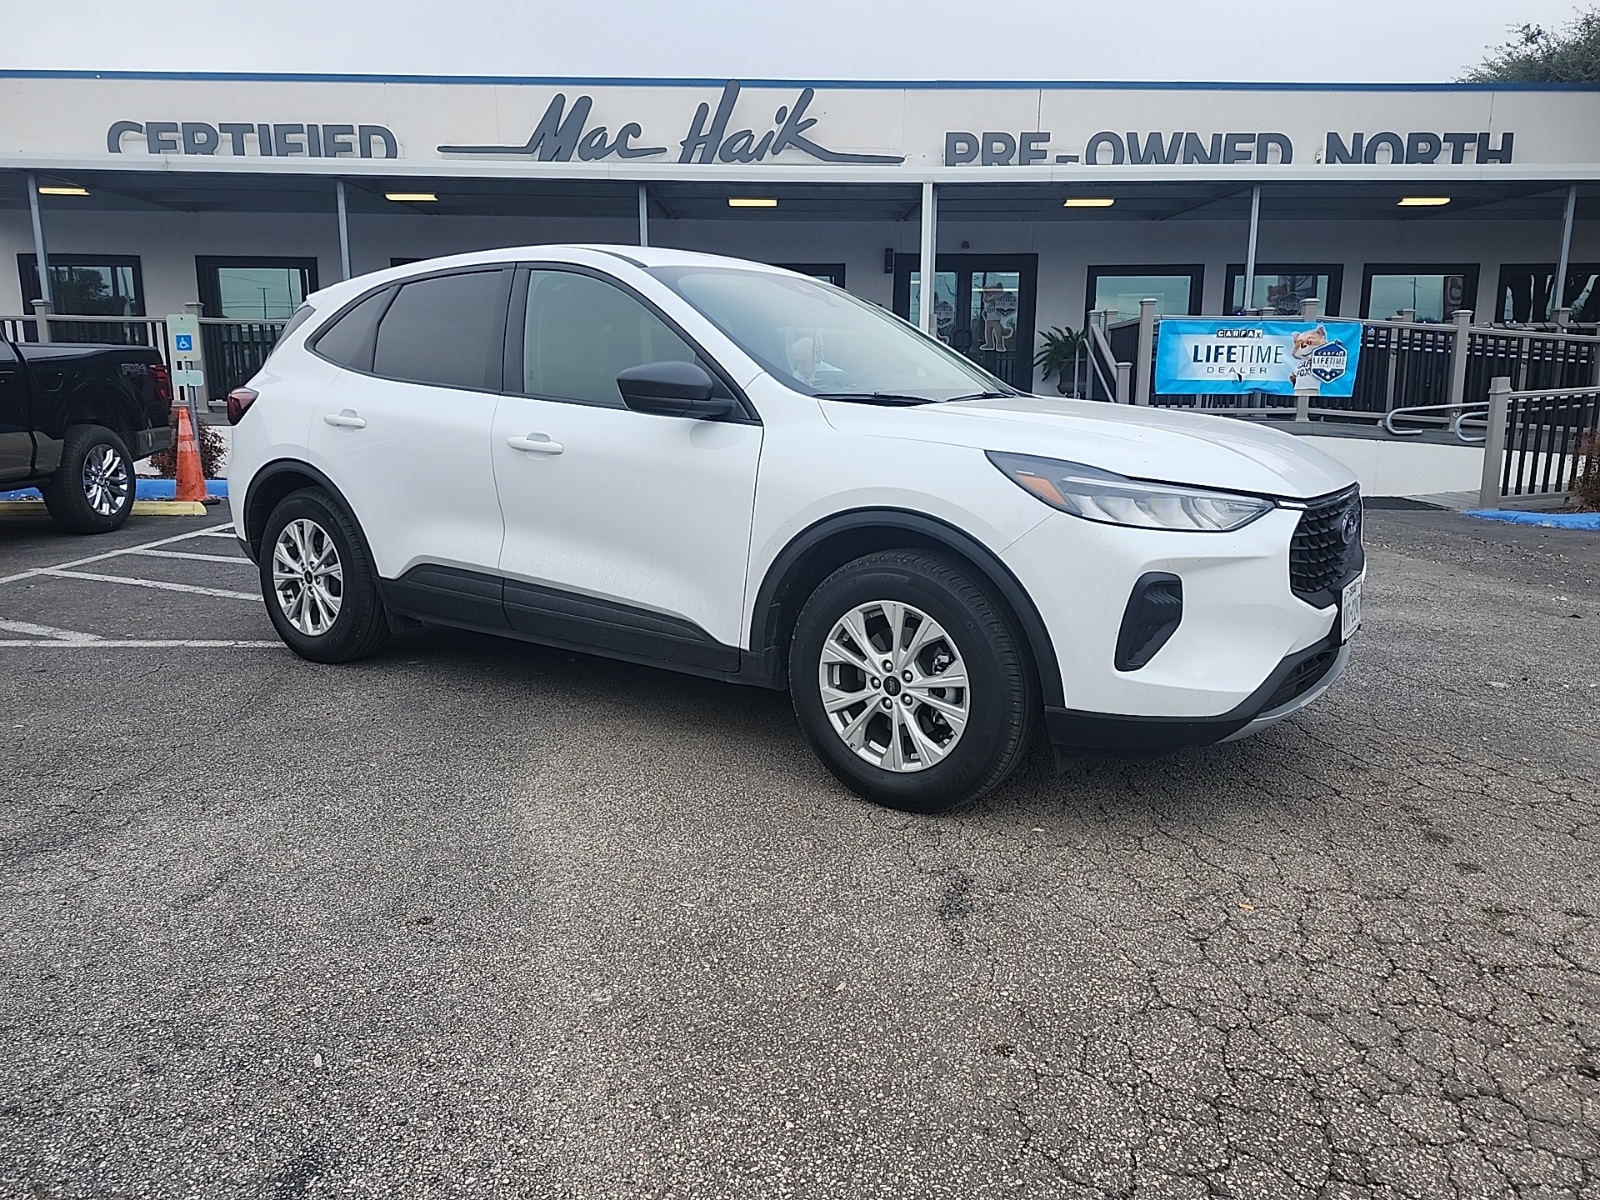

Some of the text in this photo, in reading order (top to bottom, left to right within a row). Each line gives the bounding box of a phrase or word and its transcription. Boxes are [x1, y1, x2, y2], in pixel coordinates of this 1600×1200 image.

[437, 79, 905, 164] Mac Haik
[107, 120, 398, 159] CERTIFIED
[1325, 132, 1515, 165] NORTH
[1217, 330, 1263, 338] CARFAX
[1192, 344, 1285, 364] LIFETIME
[1313, 356, 1346, 364] LIFETIME
[120, 363, 147, 376] FX4
[1206, 366, 1268, 374] DEALER
